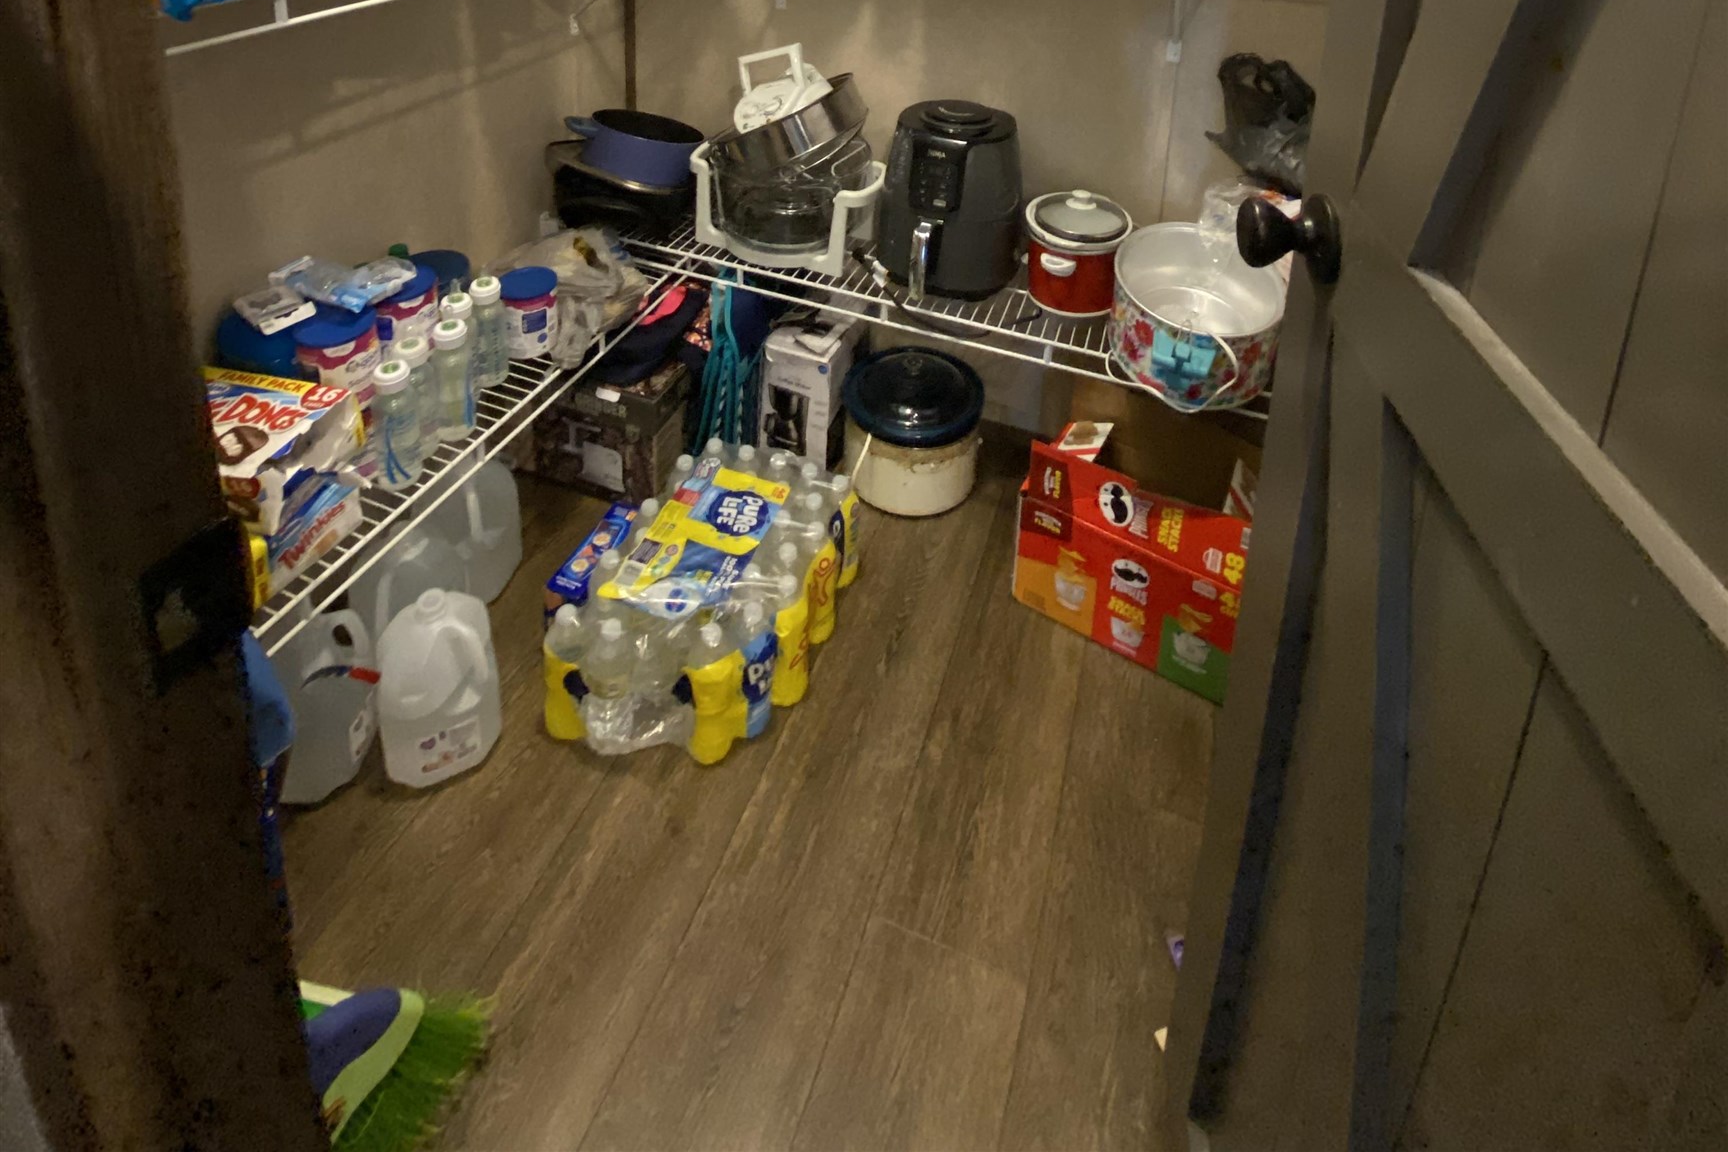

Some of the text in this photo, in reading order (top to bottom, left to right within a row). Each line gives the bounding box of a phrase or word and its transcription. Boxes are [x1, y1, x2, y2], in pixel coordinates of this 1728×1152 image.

[218, 370, 306, 392] FAMILY PACK
[308, 387, 340, 402] 16
[215, 394, 310, 431] DONGS
[277, 501, 345, 569] Twinkies
[1223, 552, 1246, 585] 48
